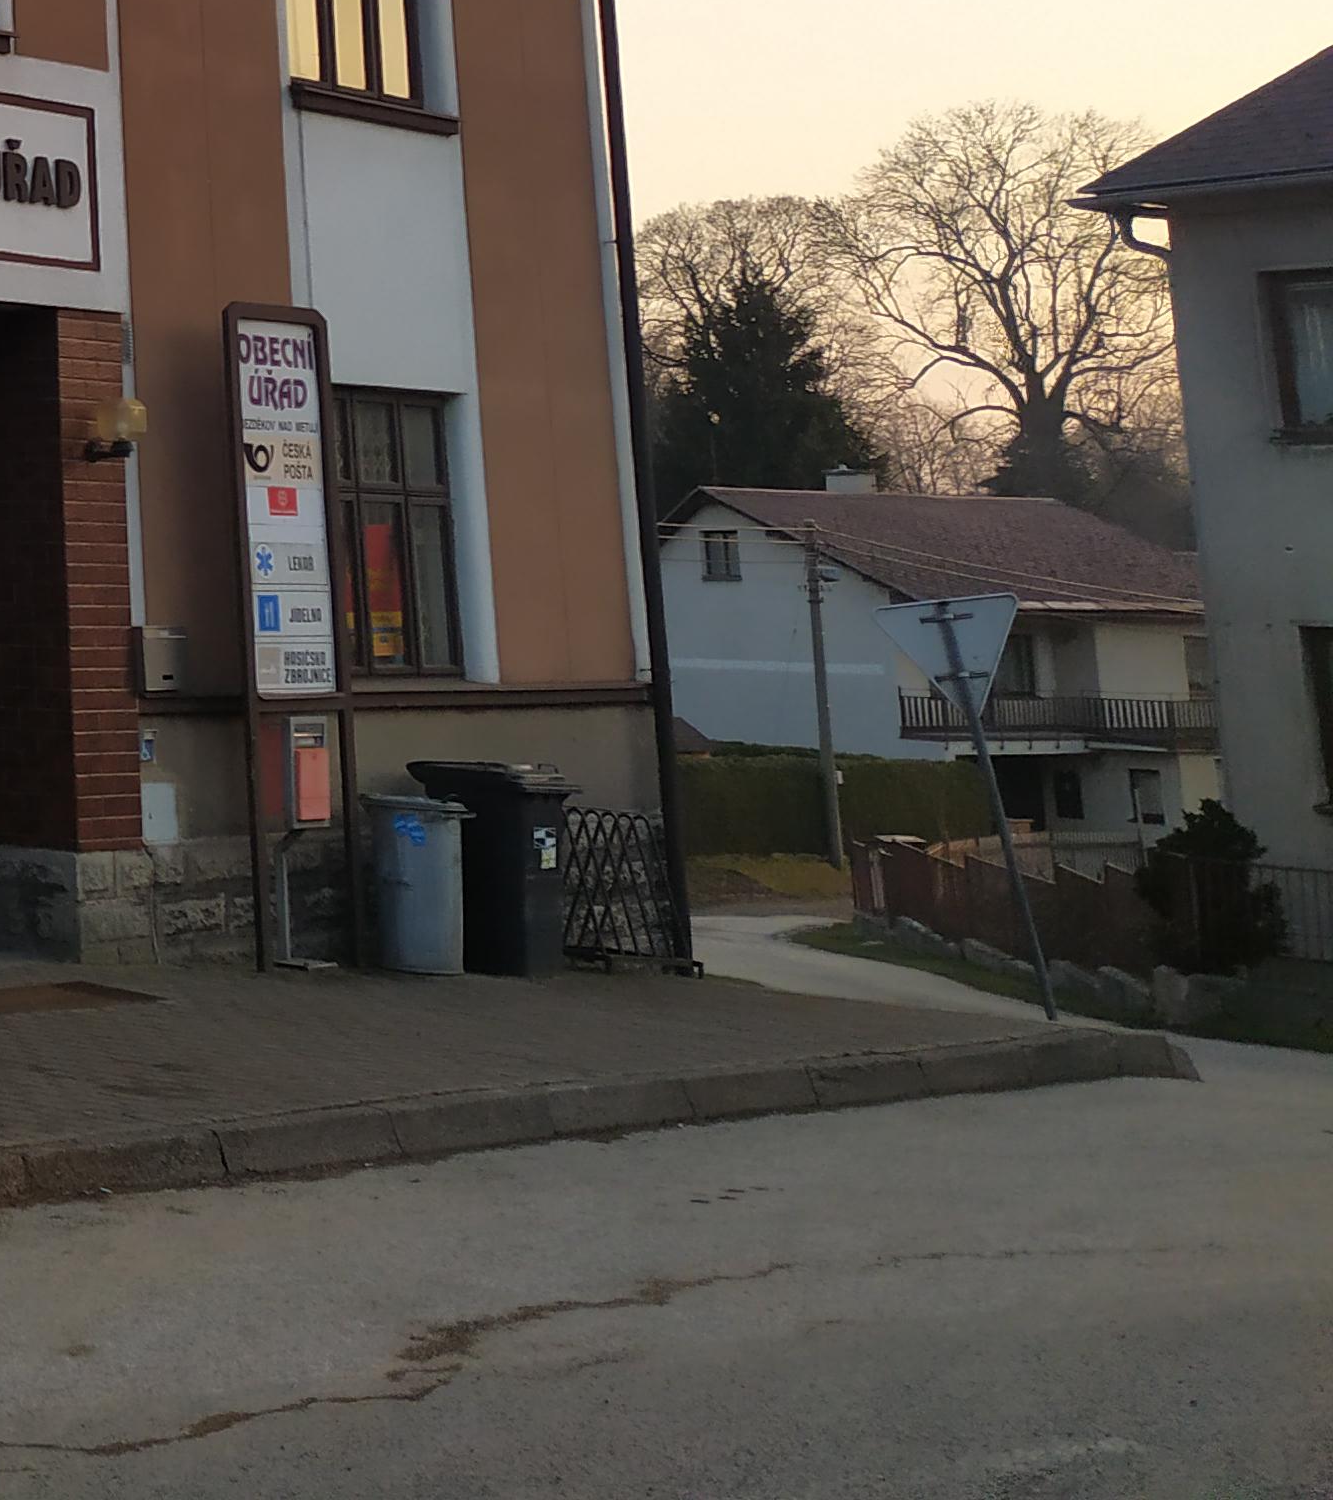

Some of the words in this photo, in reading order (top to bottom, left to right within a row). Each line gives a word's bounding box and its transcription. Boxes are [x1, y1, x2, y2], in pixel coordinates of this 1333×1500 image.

[237, 333, 314, 370] OBECNÍ
[248, 369, 308, 410] ÚŘAD
[282, 439, 313, 459] ČESKÁ
[284, 461, 313, 479] POŠTA
